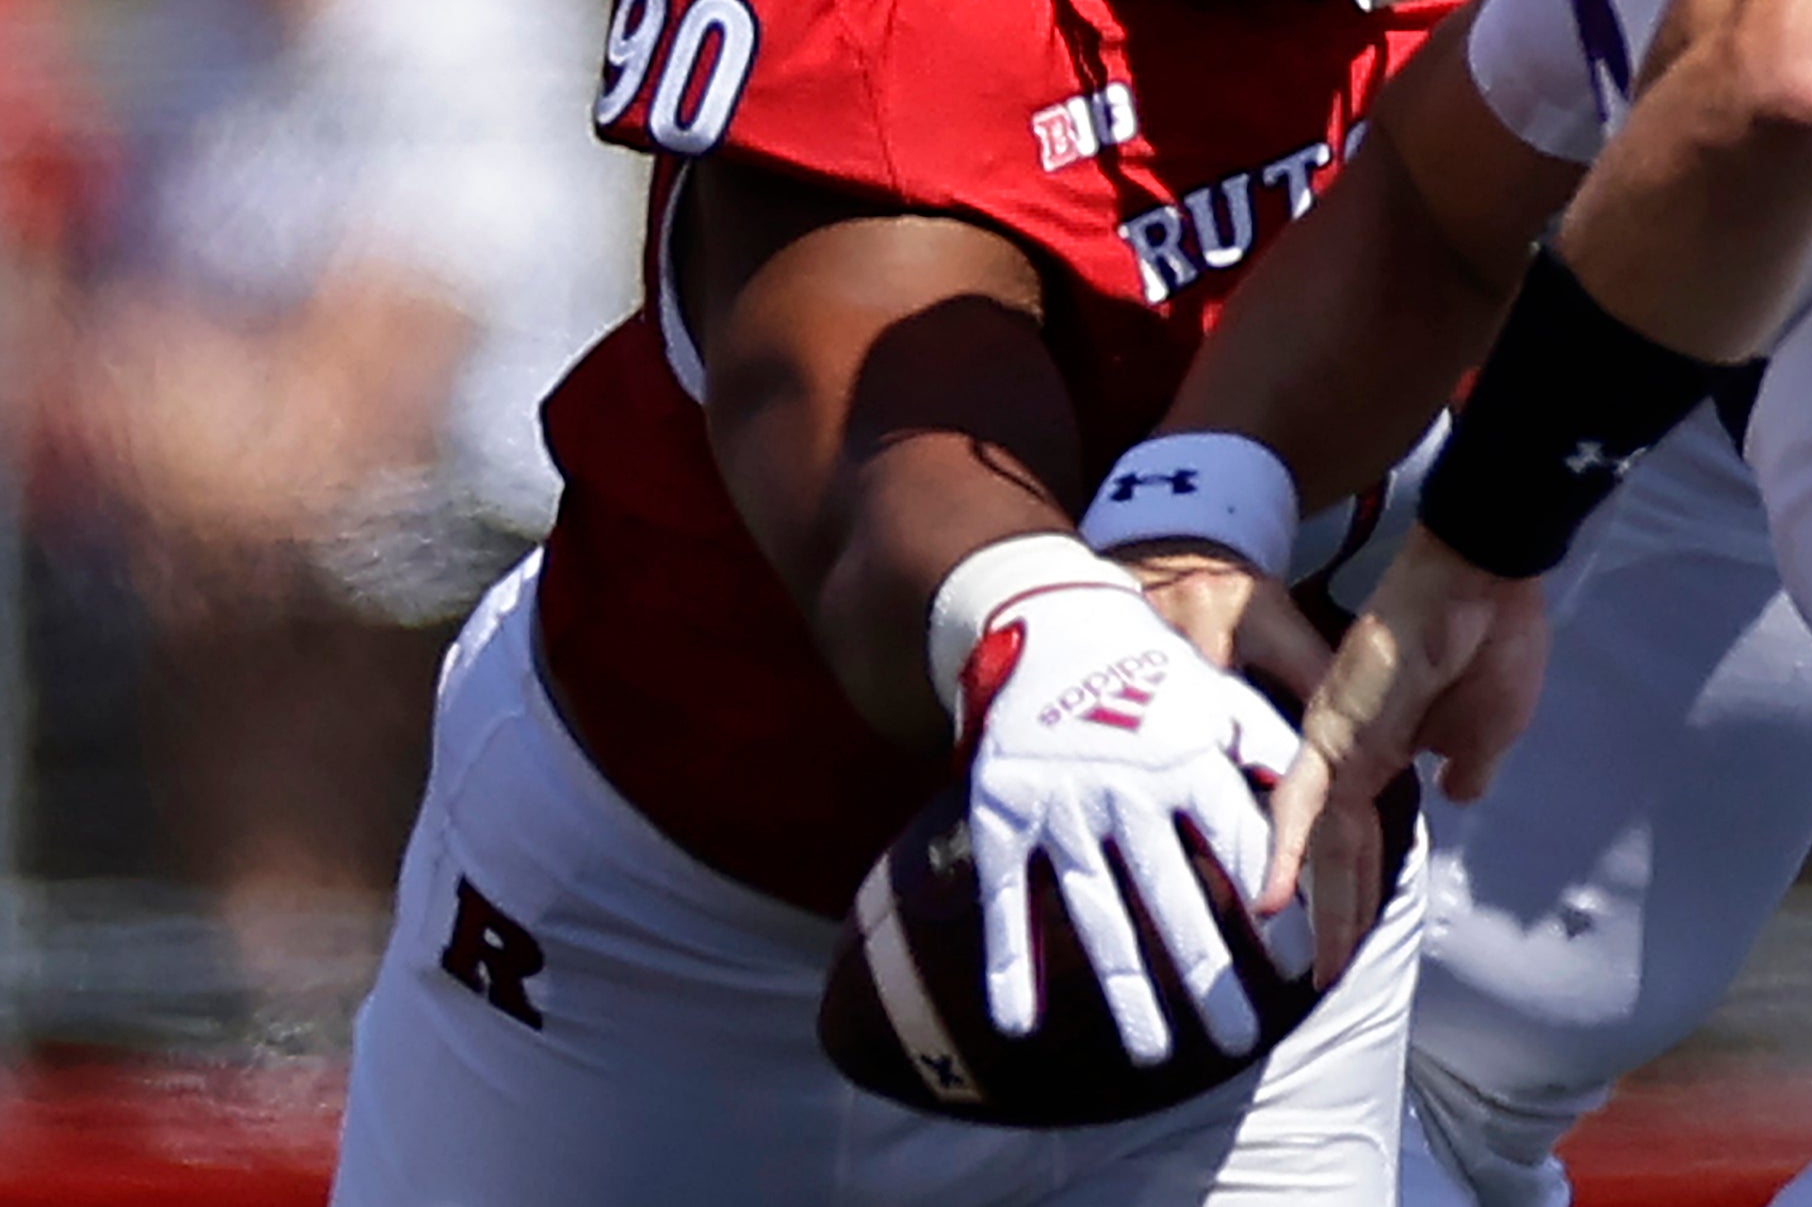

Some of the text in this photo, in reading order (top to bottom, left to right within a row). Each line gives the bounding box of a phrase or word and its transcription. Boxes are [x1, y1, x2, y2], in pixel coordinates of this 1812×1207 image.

[1117, 121, 1366, 305] RUT
[1037, 649, 1169, 728] adidas
[440, 869, 546, 1032] R
